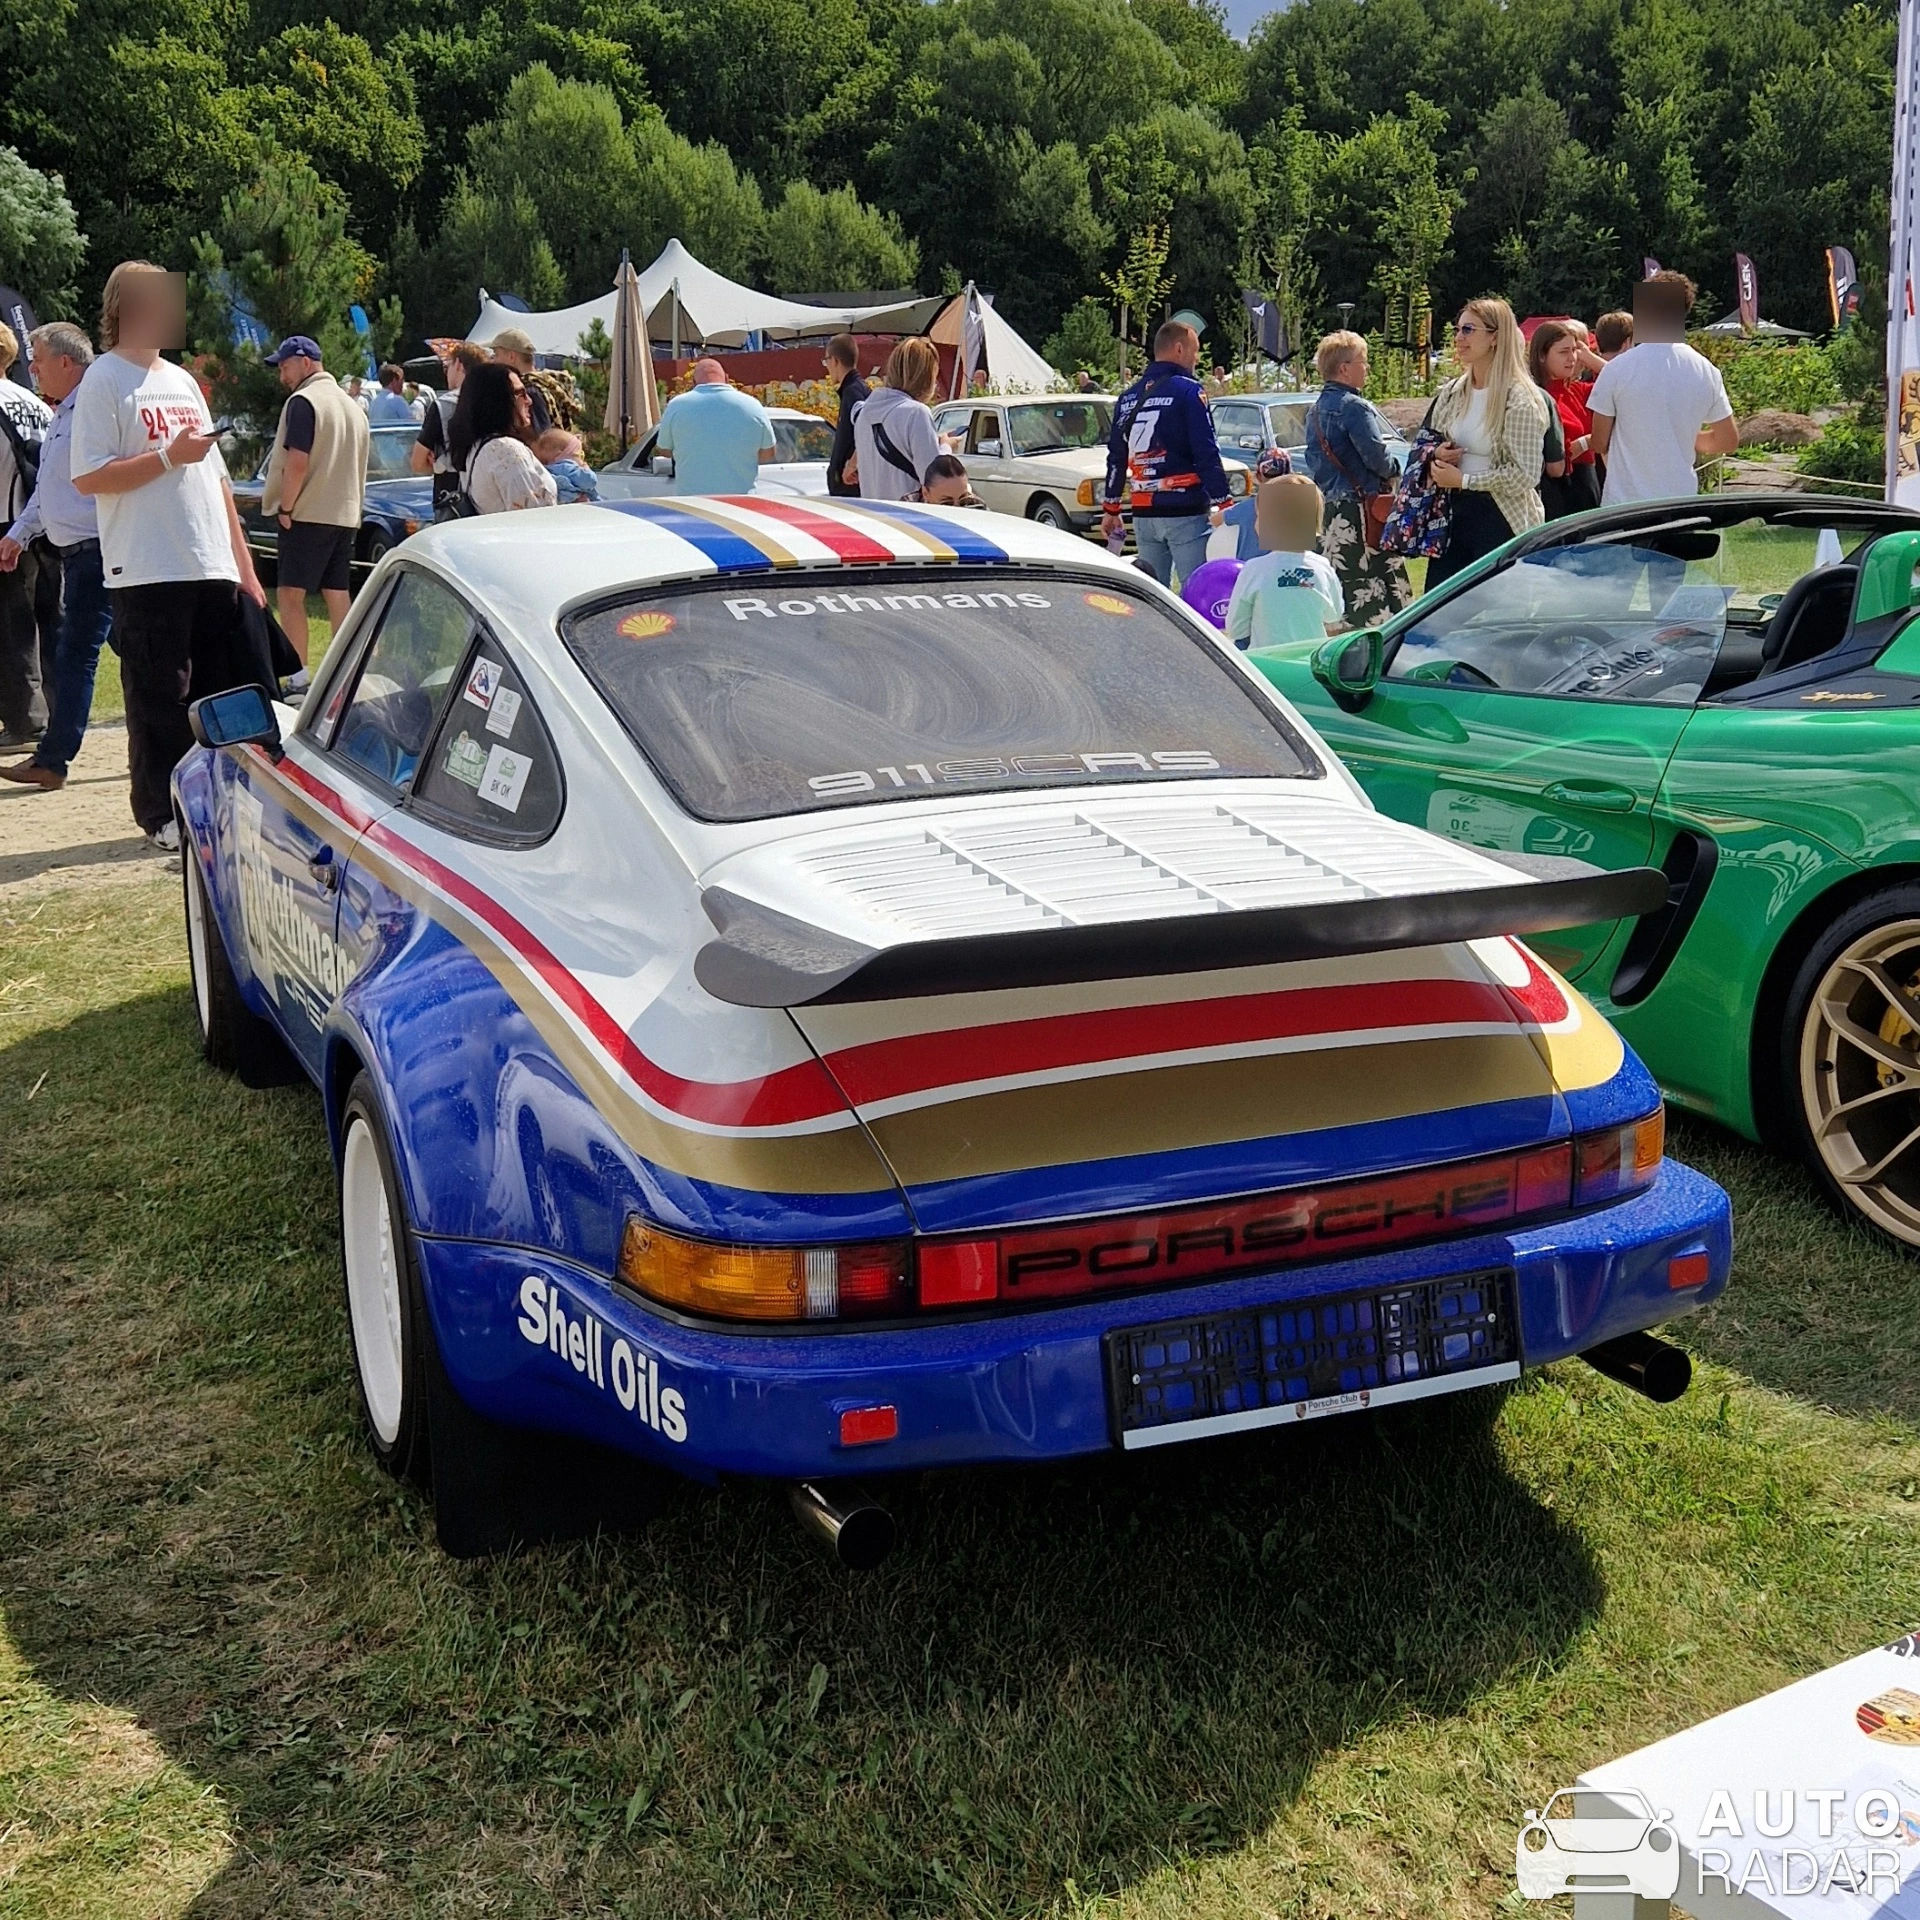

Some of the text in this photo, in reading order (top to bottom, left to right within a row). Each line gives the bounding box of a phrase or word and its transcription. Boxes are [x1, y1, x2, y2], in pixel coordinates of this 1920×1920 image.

[140, 406, 170, 441] 24
[725, 592, 1053, 621] Rothmans
[1008, 1178, 1509, 1286] PORSCHE
[518, 1276, 688, 1443] Shell Oils
[1308, 1393, 1358, 1409] Porsche Club
